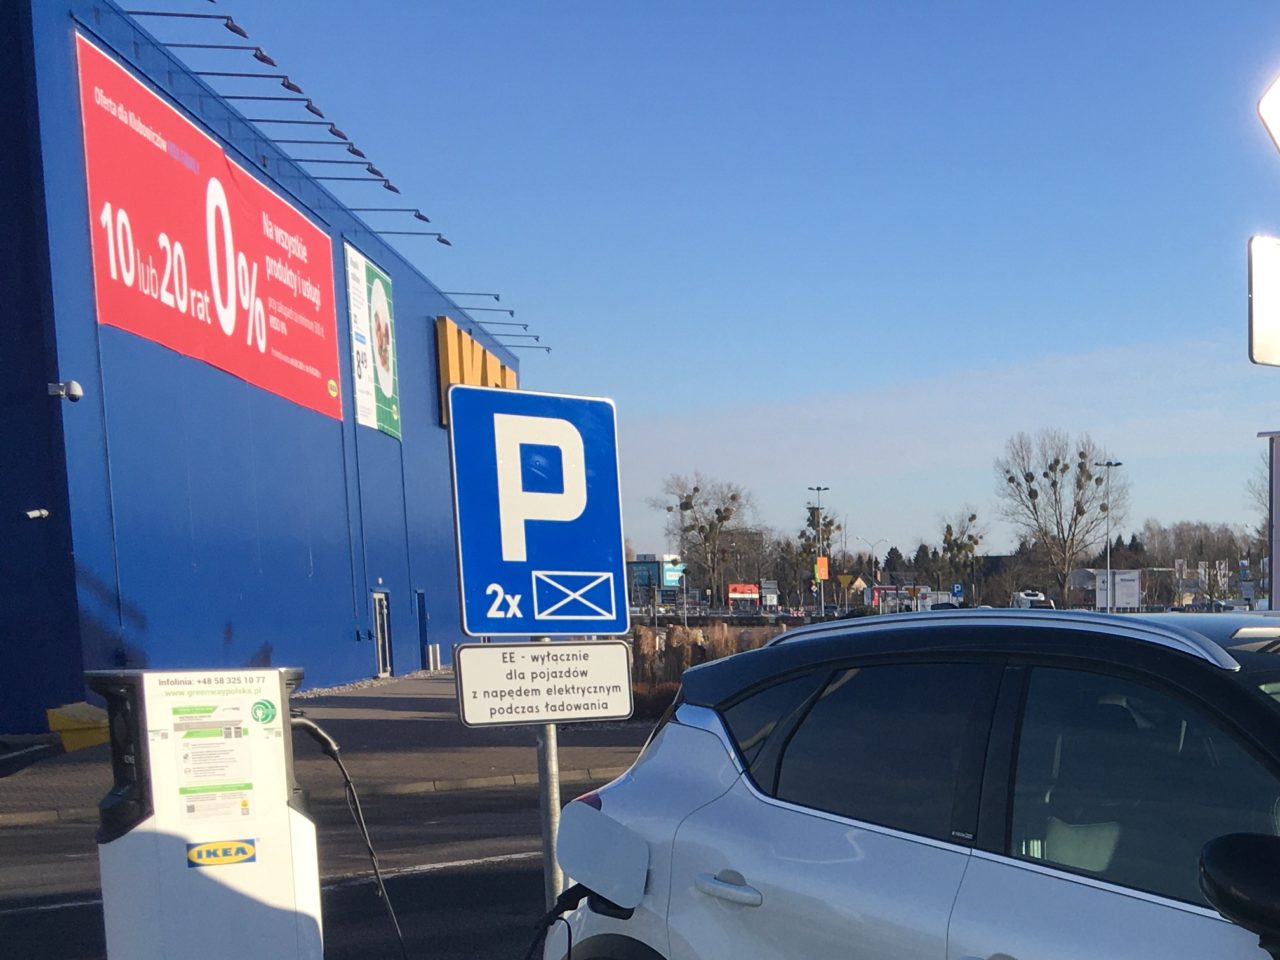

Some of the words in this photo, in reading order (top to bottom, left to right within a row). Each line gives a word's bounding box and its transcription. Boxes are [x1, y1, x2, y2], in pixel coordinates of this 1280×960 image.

[262, 211, 274, 241] Na
[273, 222, 309, 264] wszystkie
[100, 202, 135, 288] 10
[136, 250, 159, 300] lub
[158, 232, 187, 314] 20
[190, 286, 211, 326] rat
[265, 255, 298, 297] produkty
[493, 412, 588, 563] P
[485, 583, 523, 619] 2x
[502, 651, 516, 664] EE
[530, 650, 590, 665] wyłącznie
[196, 677, 212, 685] +48
[214, 676, 225, 685] 58
[244, 676, 254, 684] 10
[256, 676, 266, 684] 77
[505, 668, 526, 681] dla
[530, 667, 589, 684] pojazdów
[472, 690, 478, 699] z
[482, 685, 541, 701] napędem
[546, 682, 622, 699] elektrycznym
[489, 702, 540, 719] podczas
[544, 700, 609, 714] ładowania
[196, 846, 249, 859] IKEA
